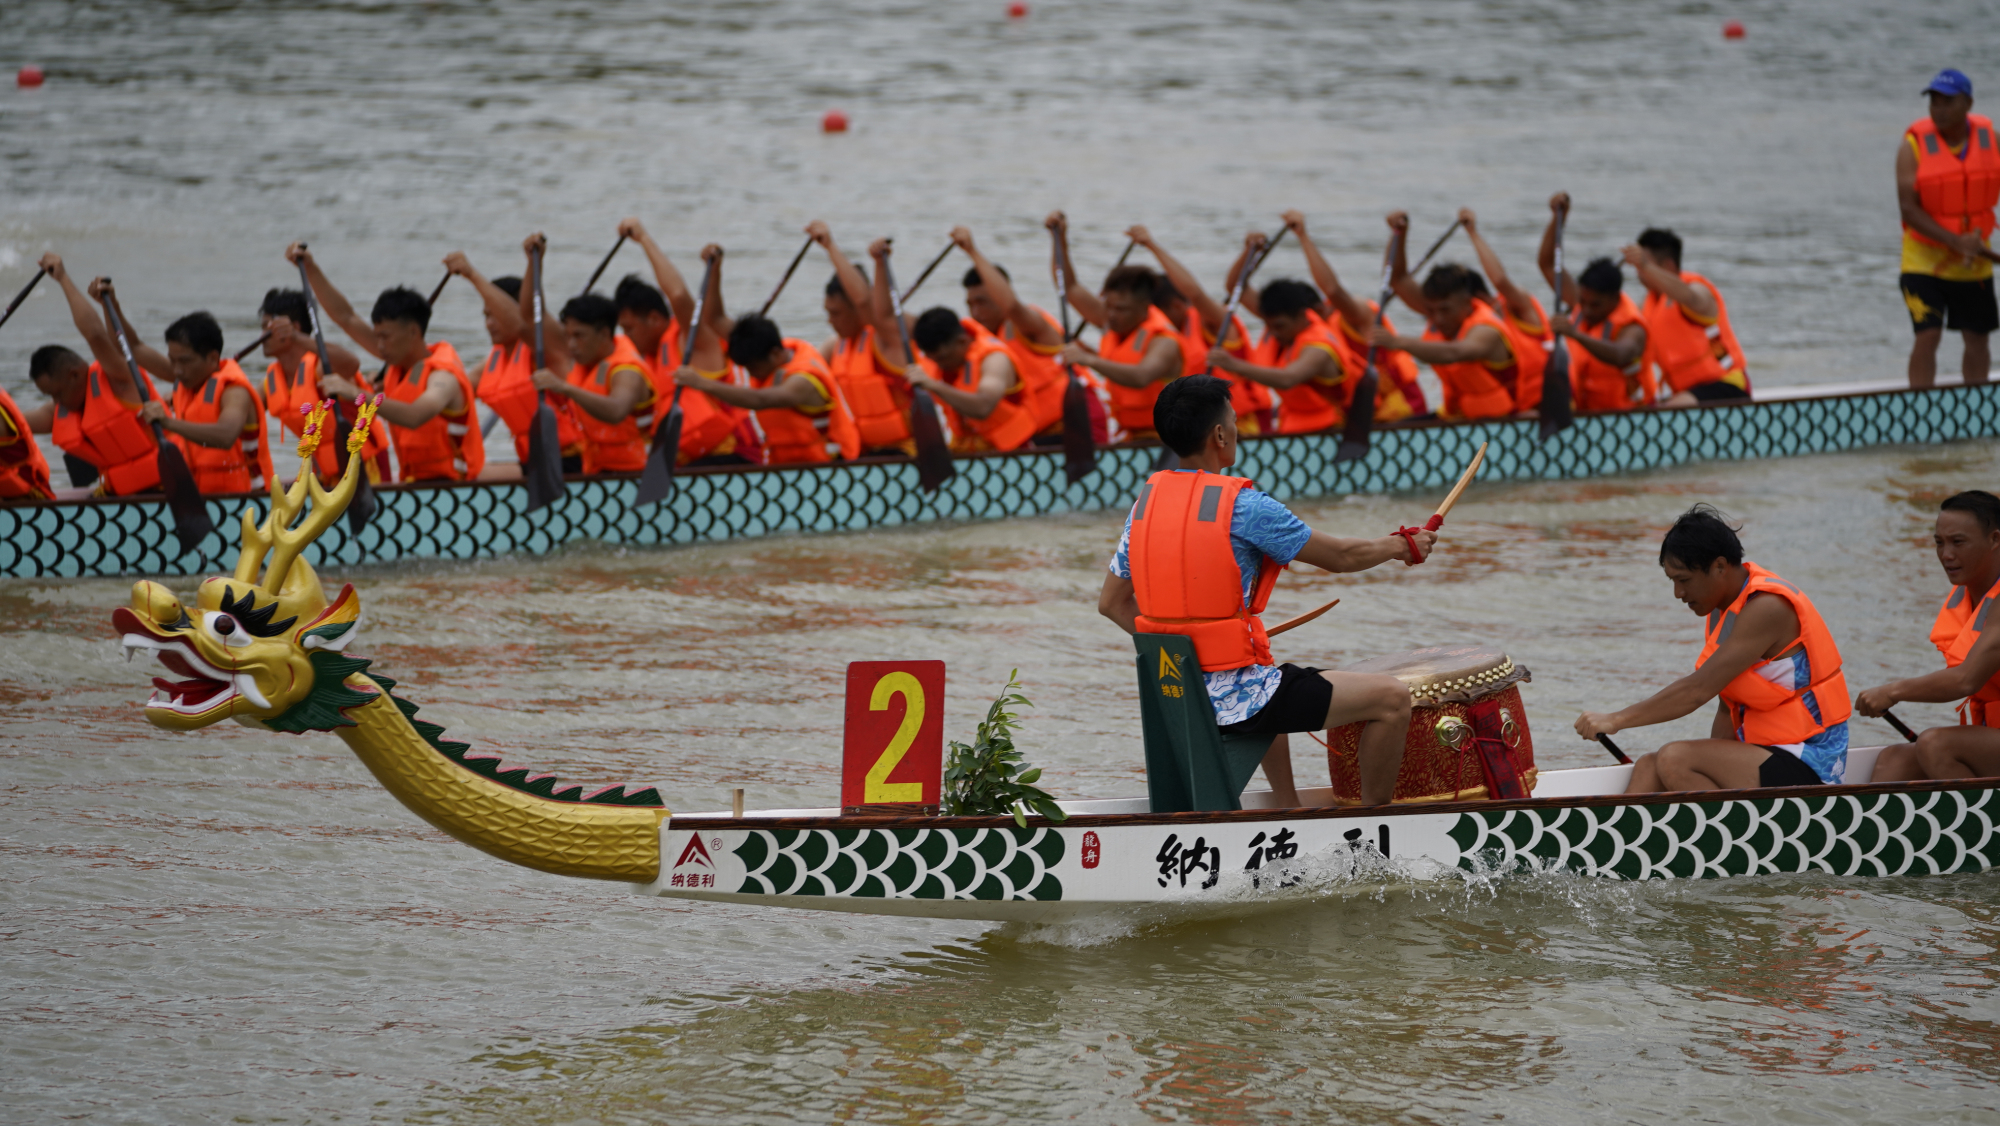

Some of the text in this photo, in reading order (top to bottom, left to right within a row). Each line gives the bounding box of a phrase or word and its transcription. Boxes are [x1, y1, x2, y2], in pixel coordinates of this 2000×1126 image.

[864, 671, 925, 803] 2
[1083, 834, 1098, 863] 龍舟
[671, 873, 715, 888] 纳德利
